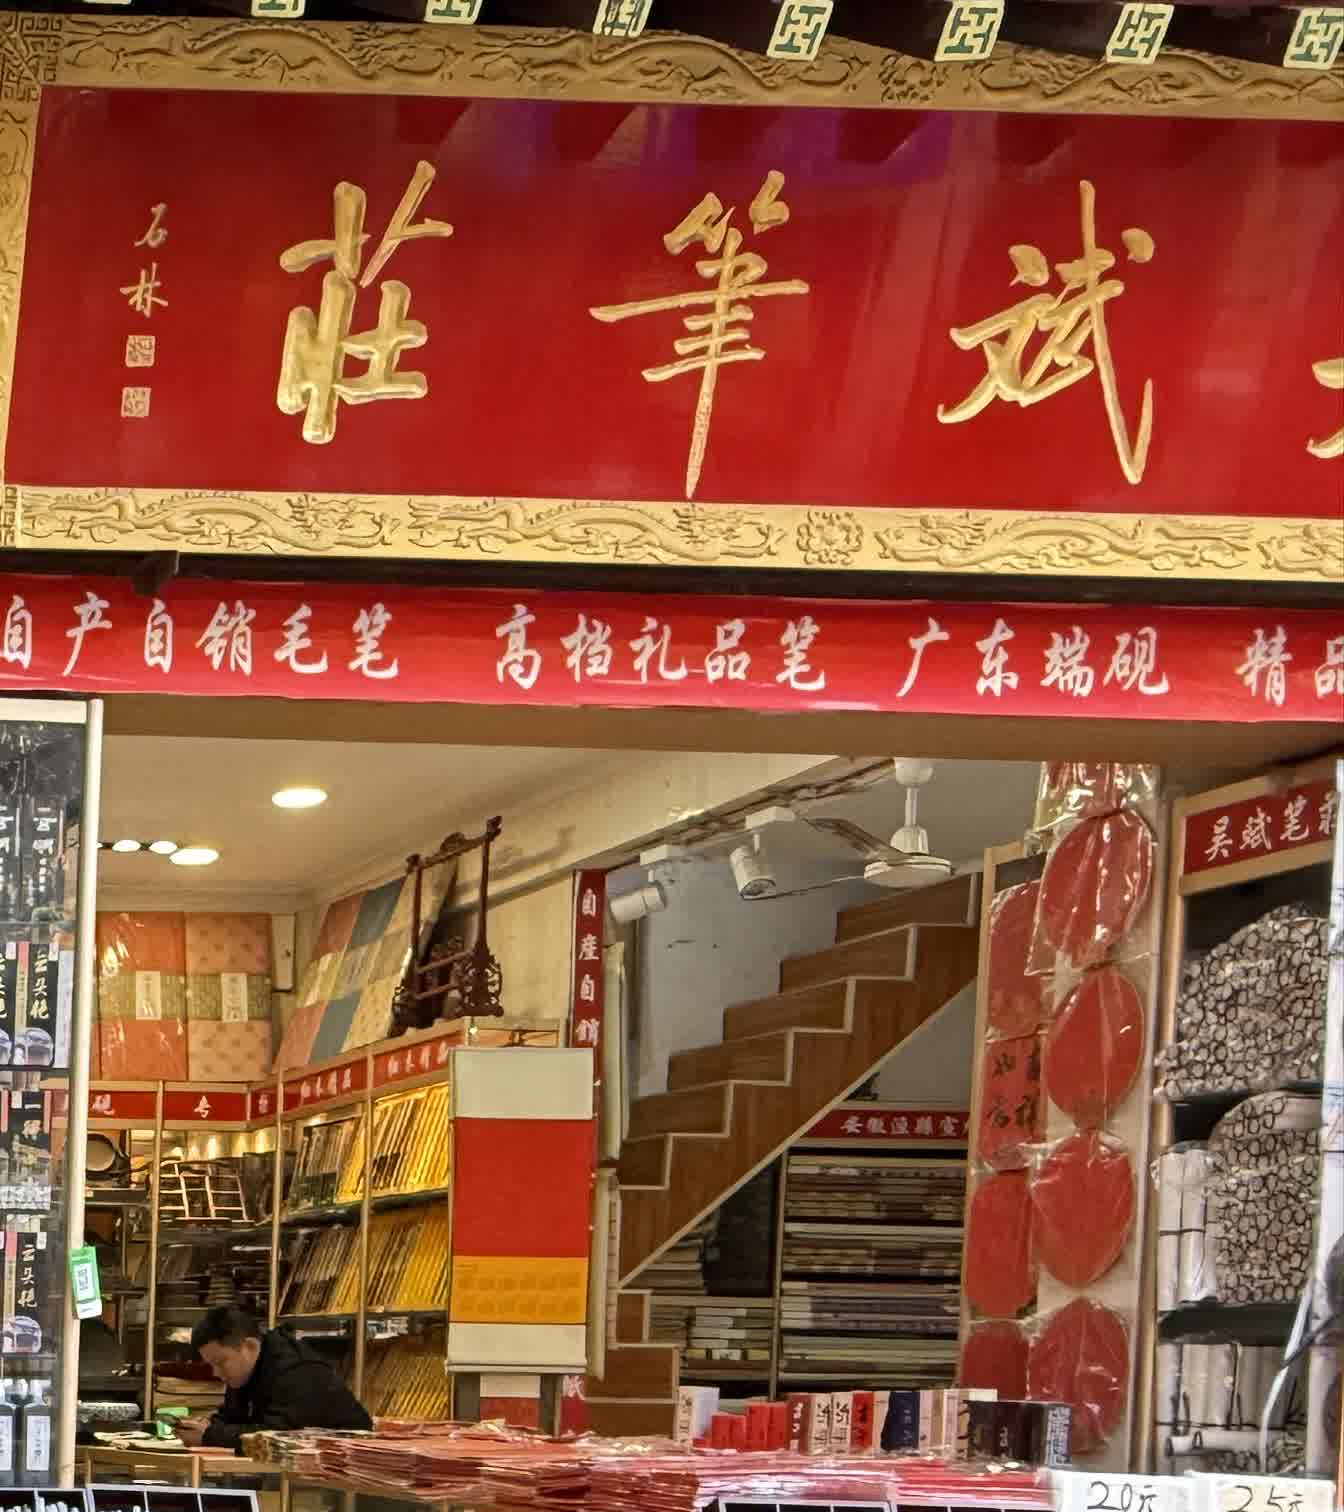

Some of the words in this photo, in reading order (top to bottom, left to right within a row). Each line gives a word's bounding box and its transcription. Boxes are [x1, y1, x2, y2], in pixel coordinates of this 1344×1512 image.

[2, 590, 401, 680] 自产自销毛笔
[495, 609, 827, 695] 高档礼品笔
[897, 618, 1170, 699] 广东端砚
